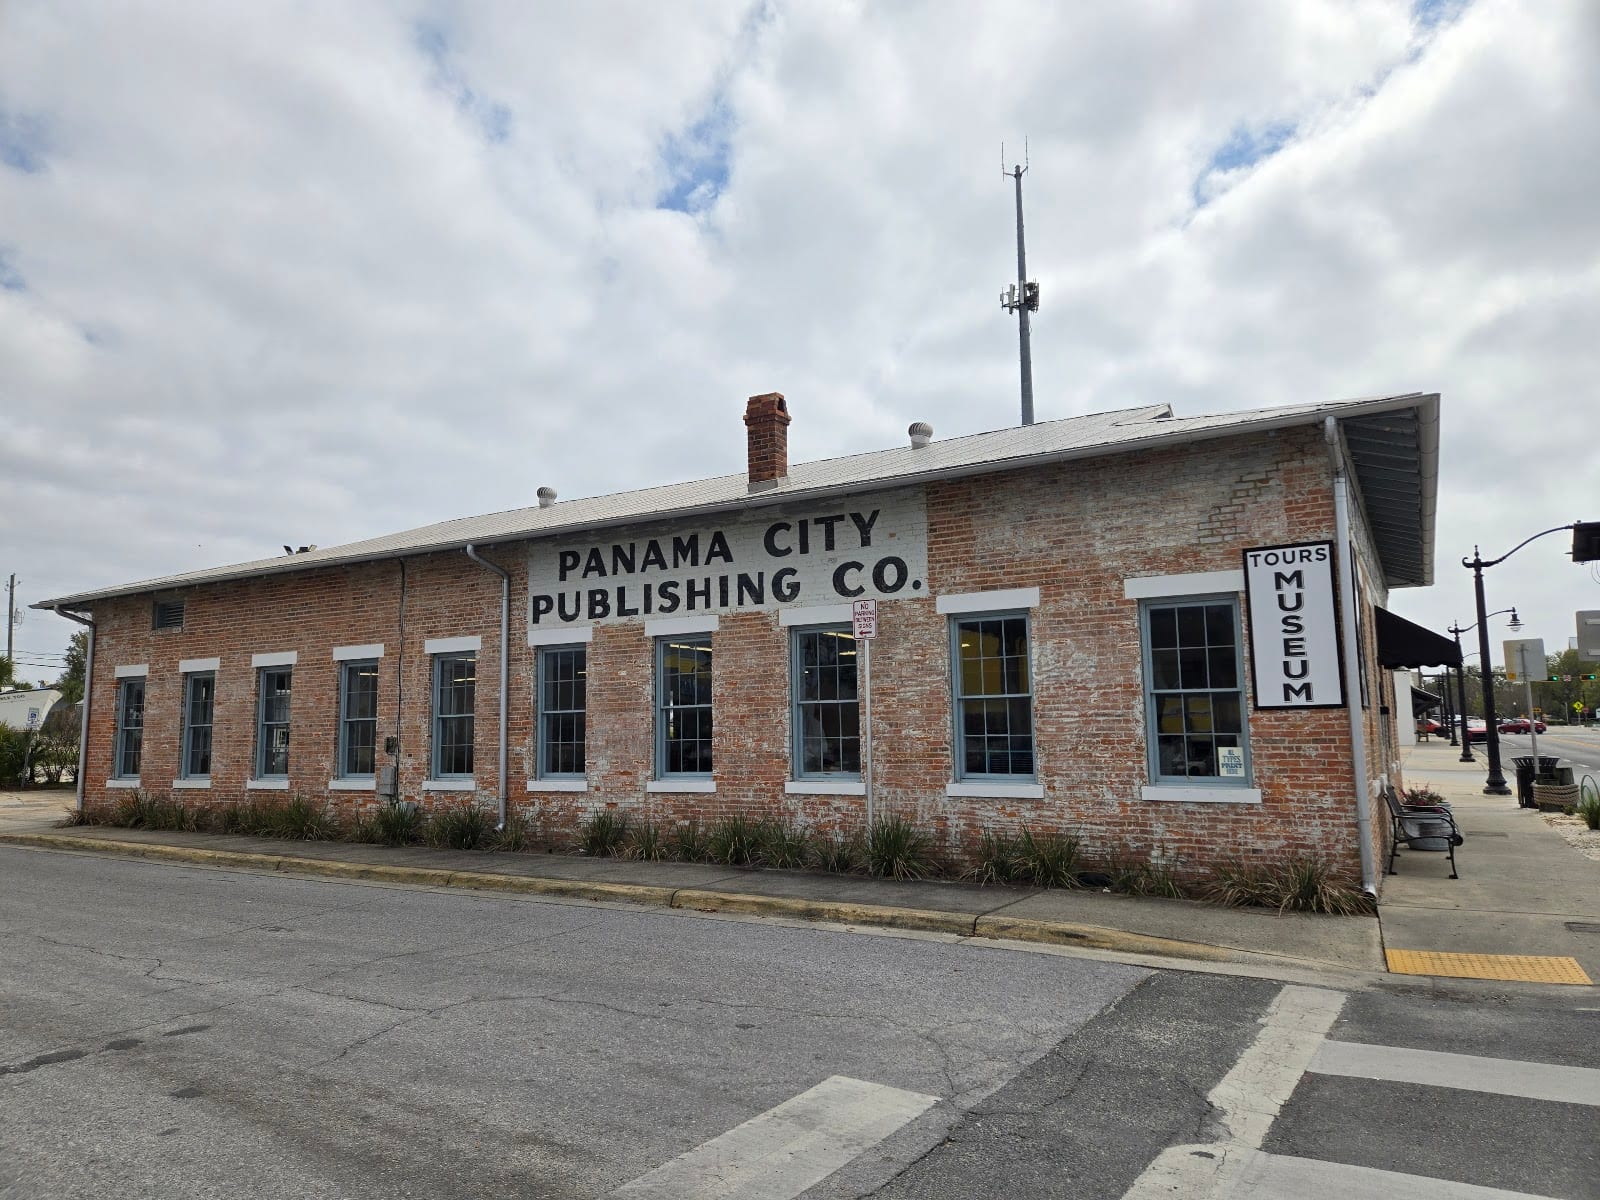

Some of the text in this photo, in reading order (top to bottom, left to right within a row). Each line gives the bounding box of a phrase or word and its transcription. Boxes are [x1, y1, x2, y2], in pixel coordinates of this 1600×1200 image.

[558, 509, 880, 582] PANAMA CITY
[1249, 547, 1327, 567] TOURS
[532, 556, 922, 624] PUBLISHING CO.
[1274, 569, 1314, 703] MUSEUM
